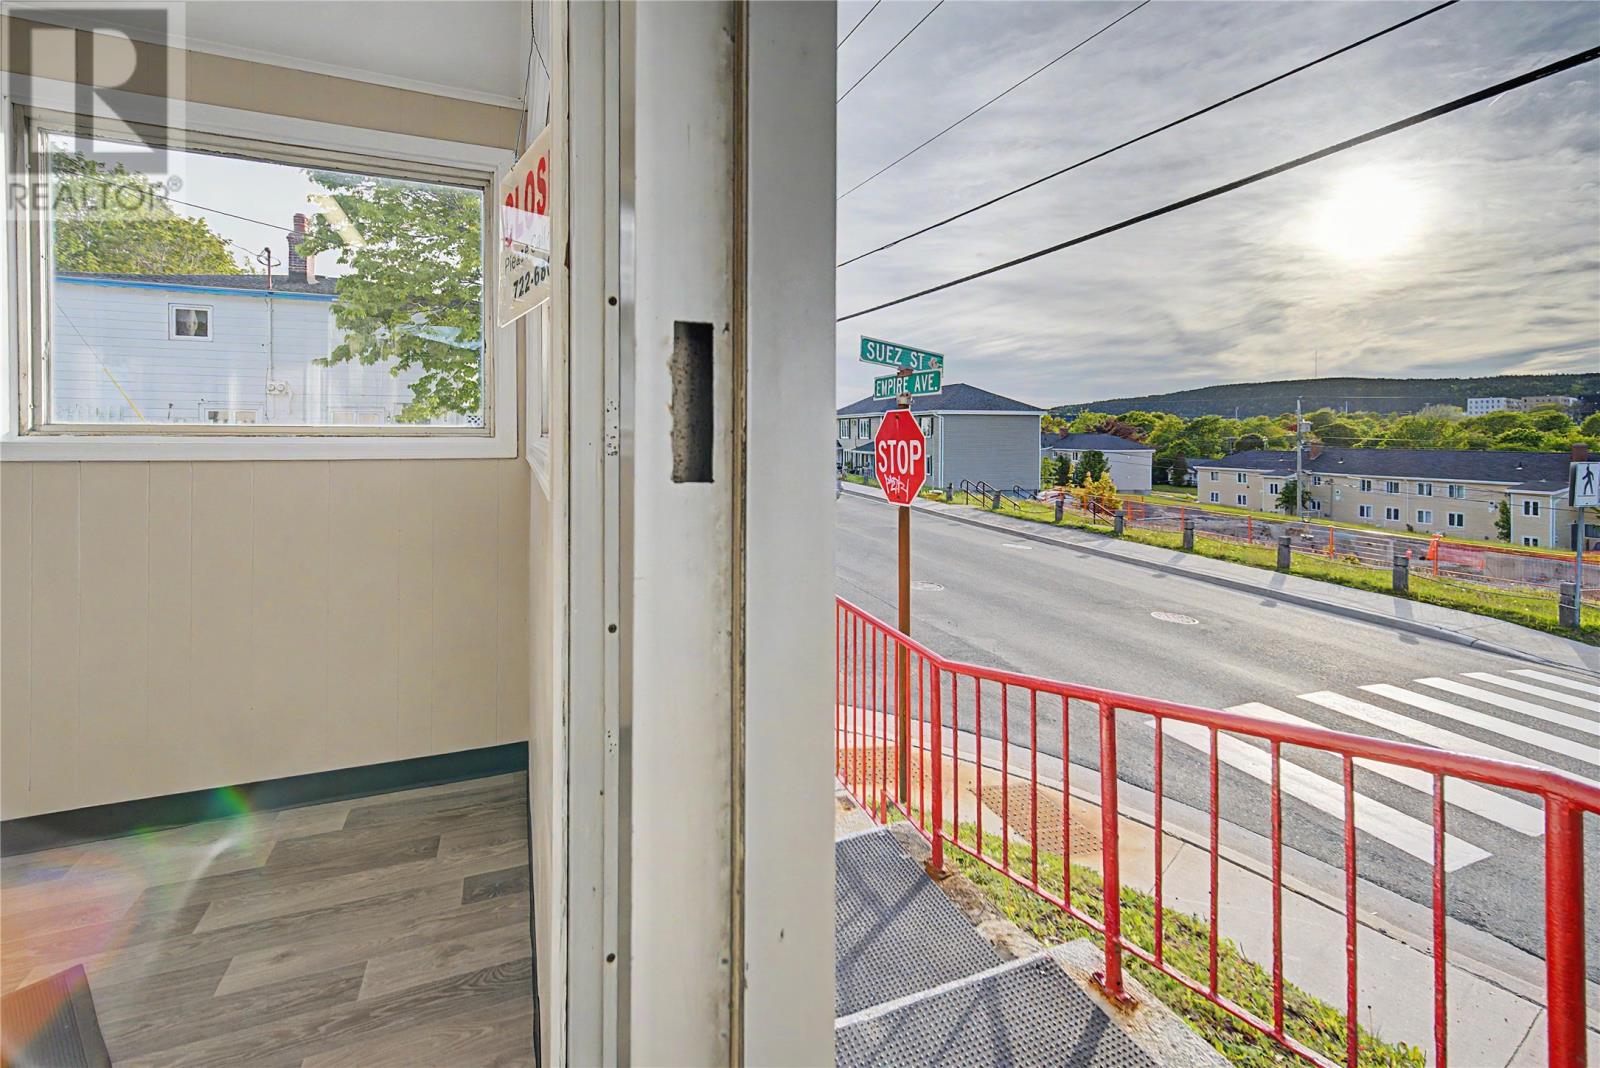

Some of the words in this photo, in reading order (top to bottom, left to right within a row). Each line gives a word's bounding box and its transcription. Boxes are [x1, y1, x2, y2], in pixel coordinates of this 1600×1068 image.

[866, 341, 902, 366] SUEZ
[910, 351, 925, 370] ST
[876, 376, 908, 397] EMPIRE
[878, 439, 922, 476] STOP
